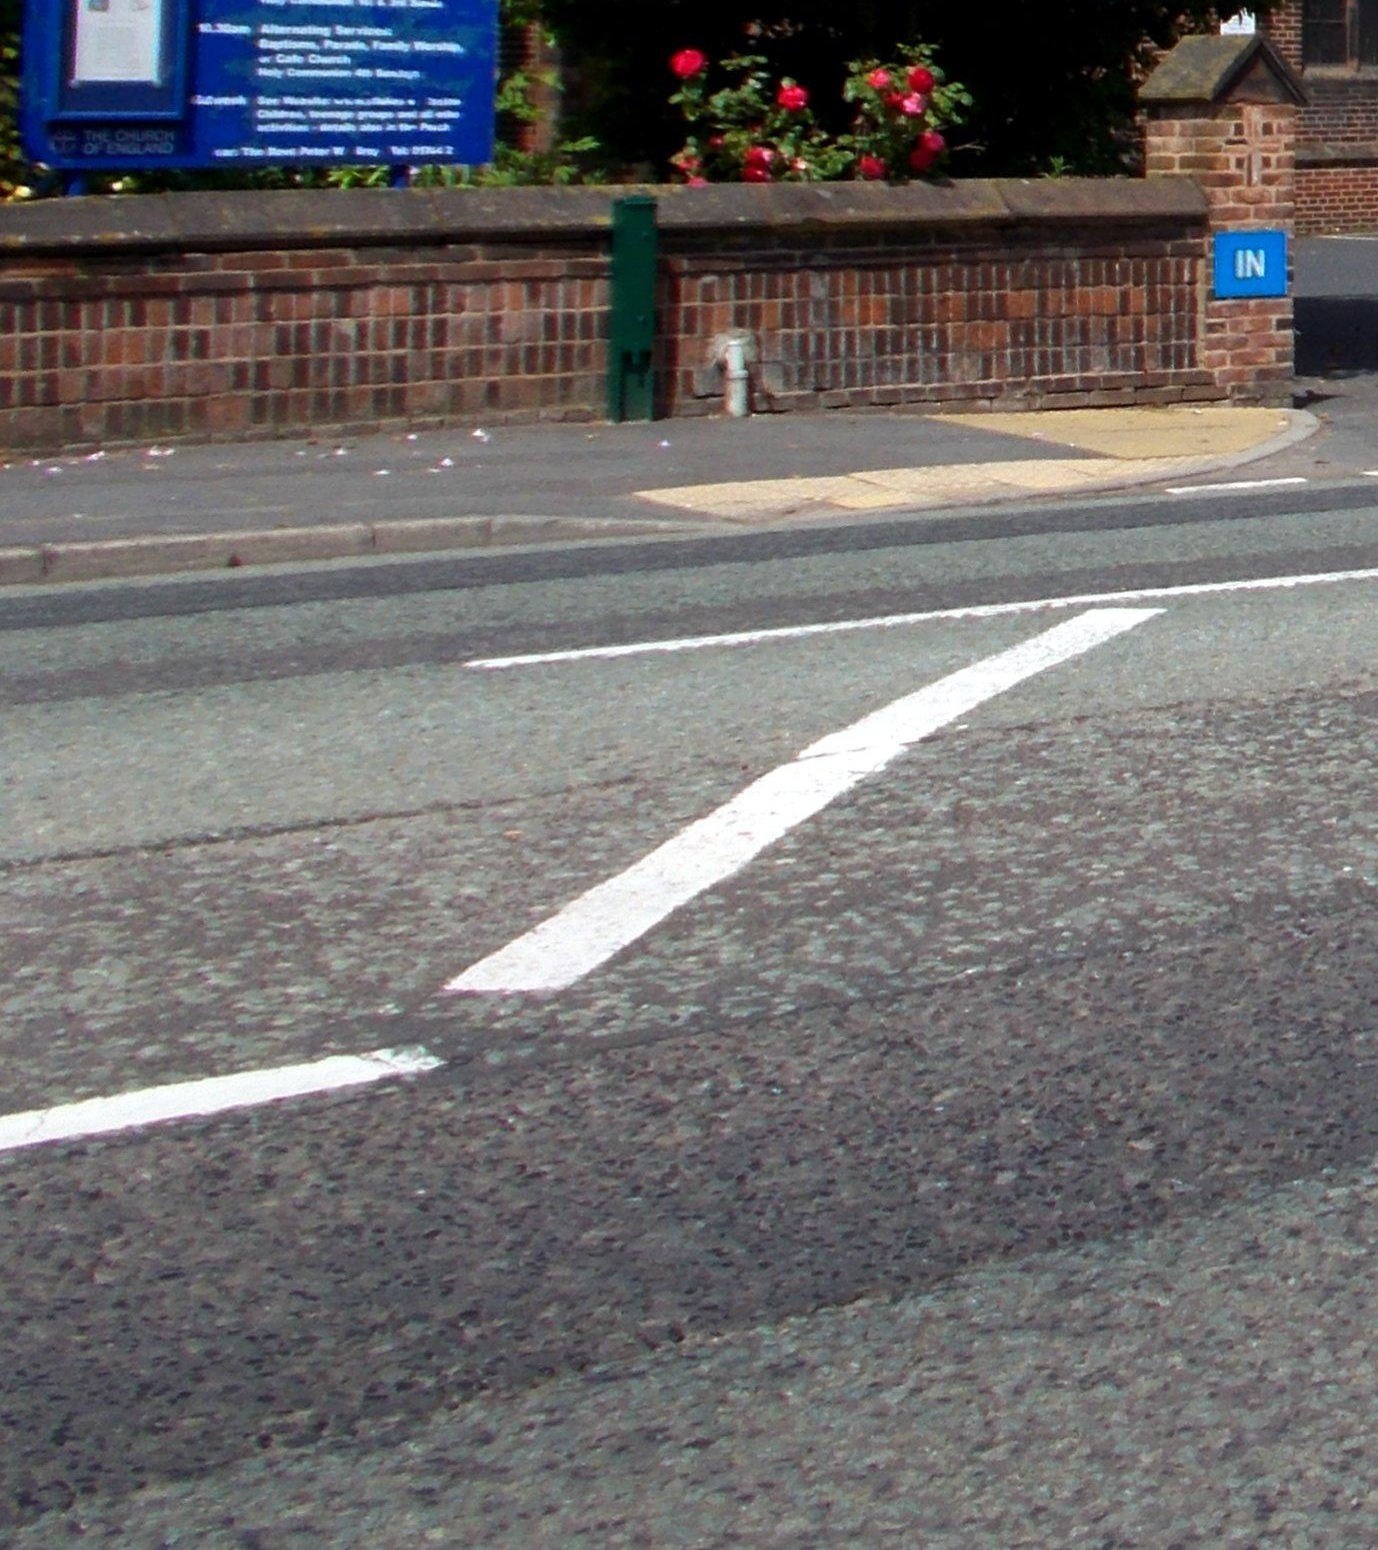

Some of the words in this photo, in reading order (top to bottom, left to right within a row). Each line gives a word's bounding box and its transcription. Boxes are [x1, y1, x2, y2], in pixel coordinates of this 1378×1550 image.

[84, 130, 112, 142] THE
[114, 130, 175, 142] CHURCH
[82, 142, 101, 155] OF
[105, 142, 175, 155] ENGLAND
[1234, 248, 1266, 279] IN
